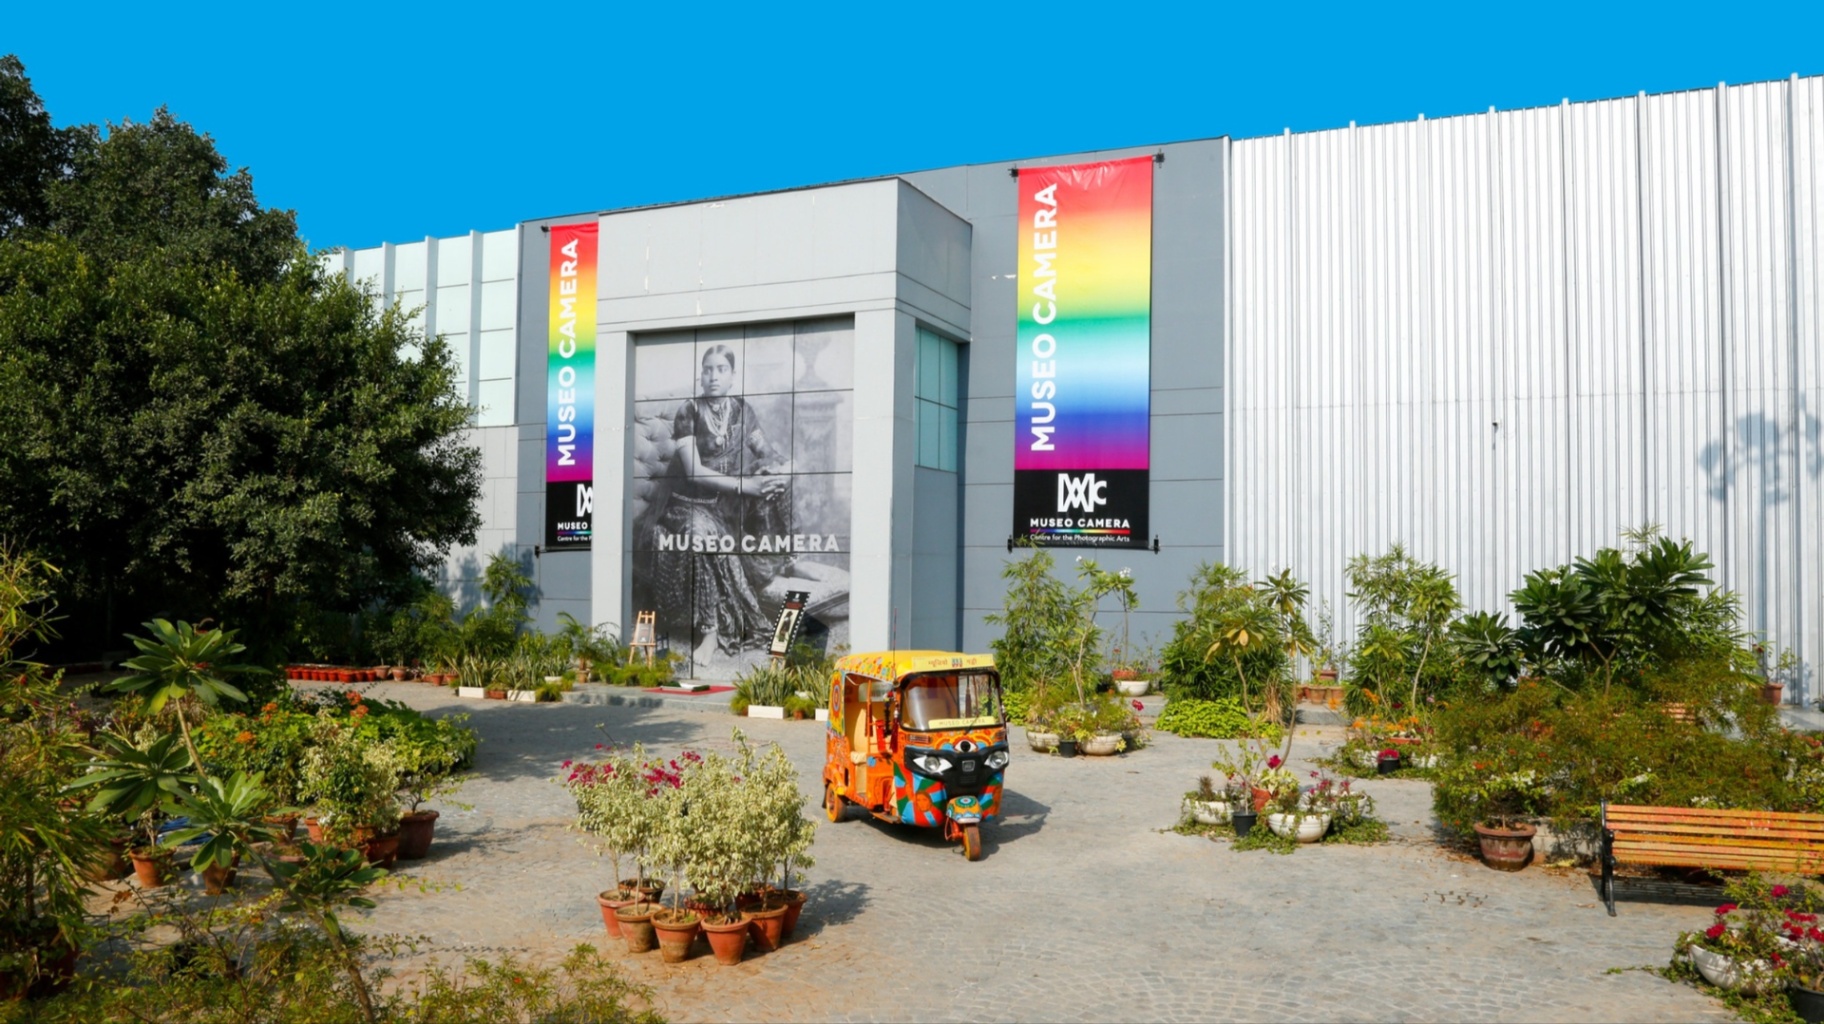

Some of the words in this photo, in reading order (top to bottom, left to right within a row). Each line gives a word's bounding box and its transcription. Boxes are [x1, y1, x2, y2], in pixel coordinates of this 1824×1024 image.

[1031, 182, 1058, 325] CAMERA
[558, 238, 579, 359] CAMERA
[557, 366, 577, 466] MUSEO
[1031, 333, 1057, 451] MUSEO
[557, 522, 588, 530] MUSEO
[659, 534, 736, 552] MUSEO
[741, 534, 840, 552] CAMERA
[1029, 518, 1074, 528] MUSEO
[1077, 518, 1131, 528] CAMERA
[1074, 534, 1115, 543] Photographic
